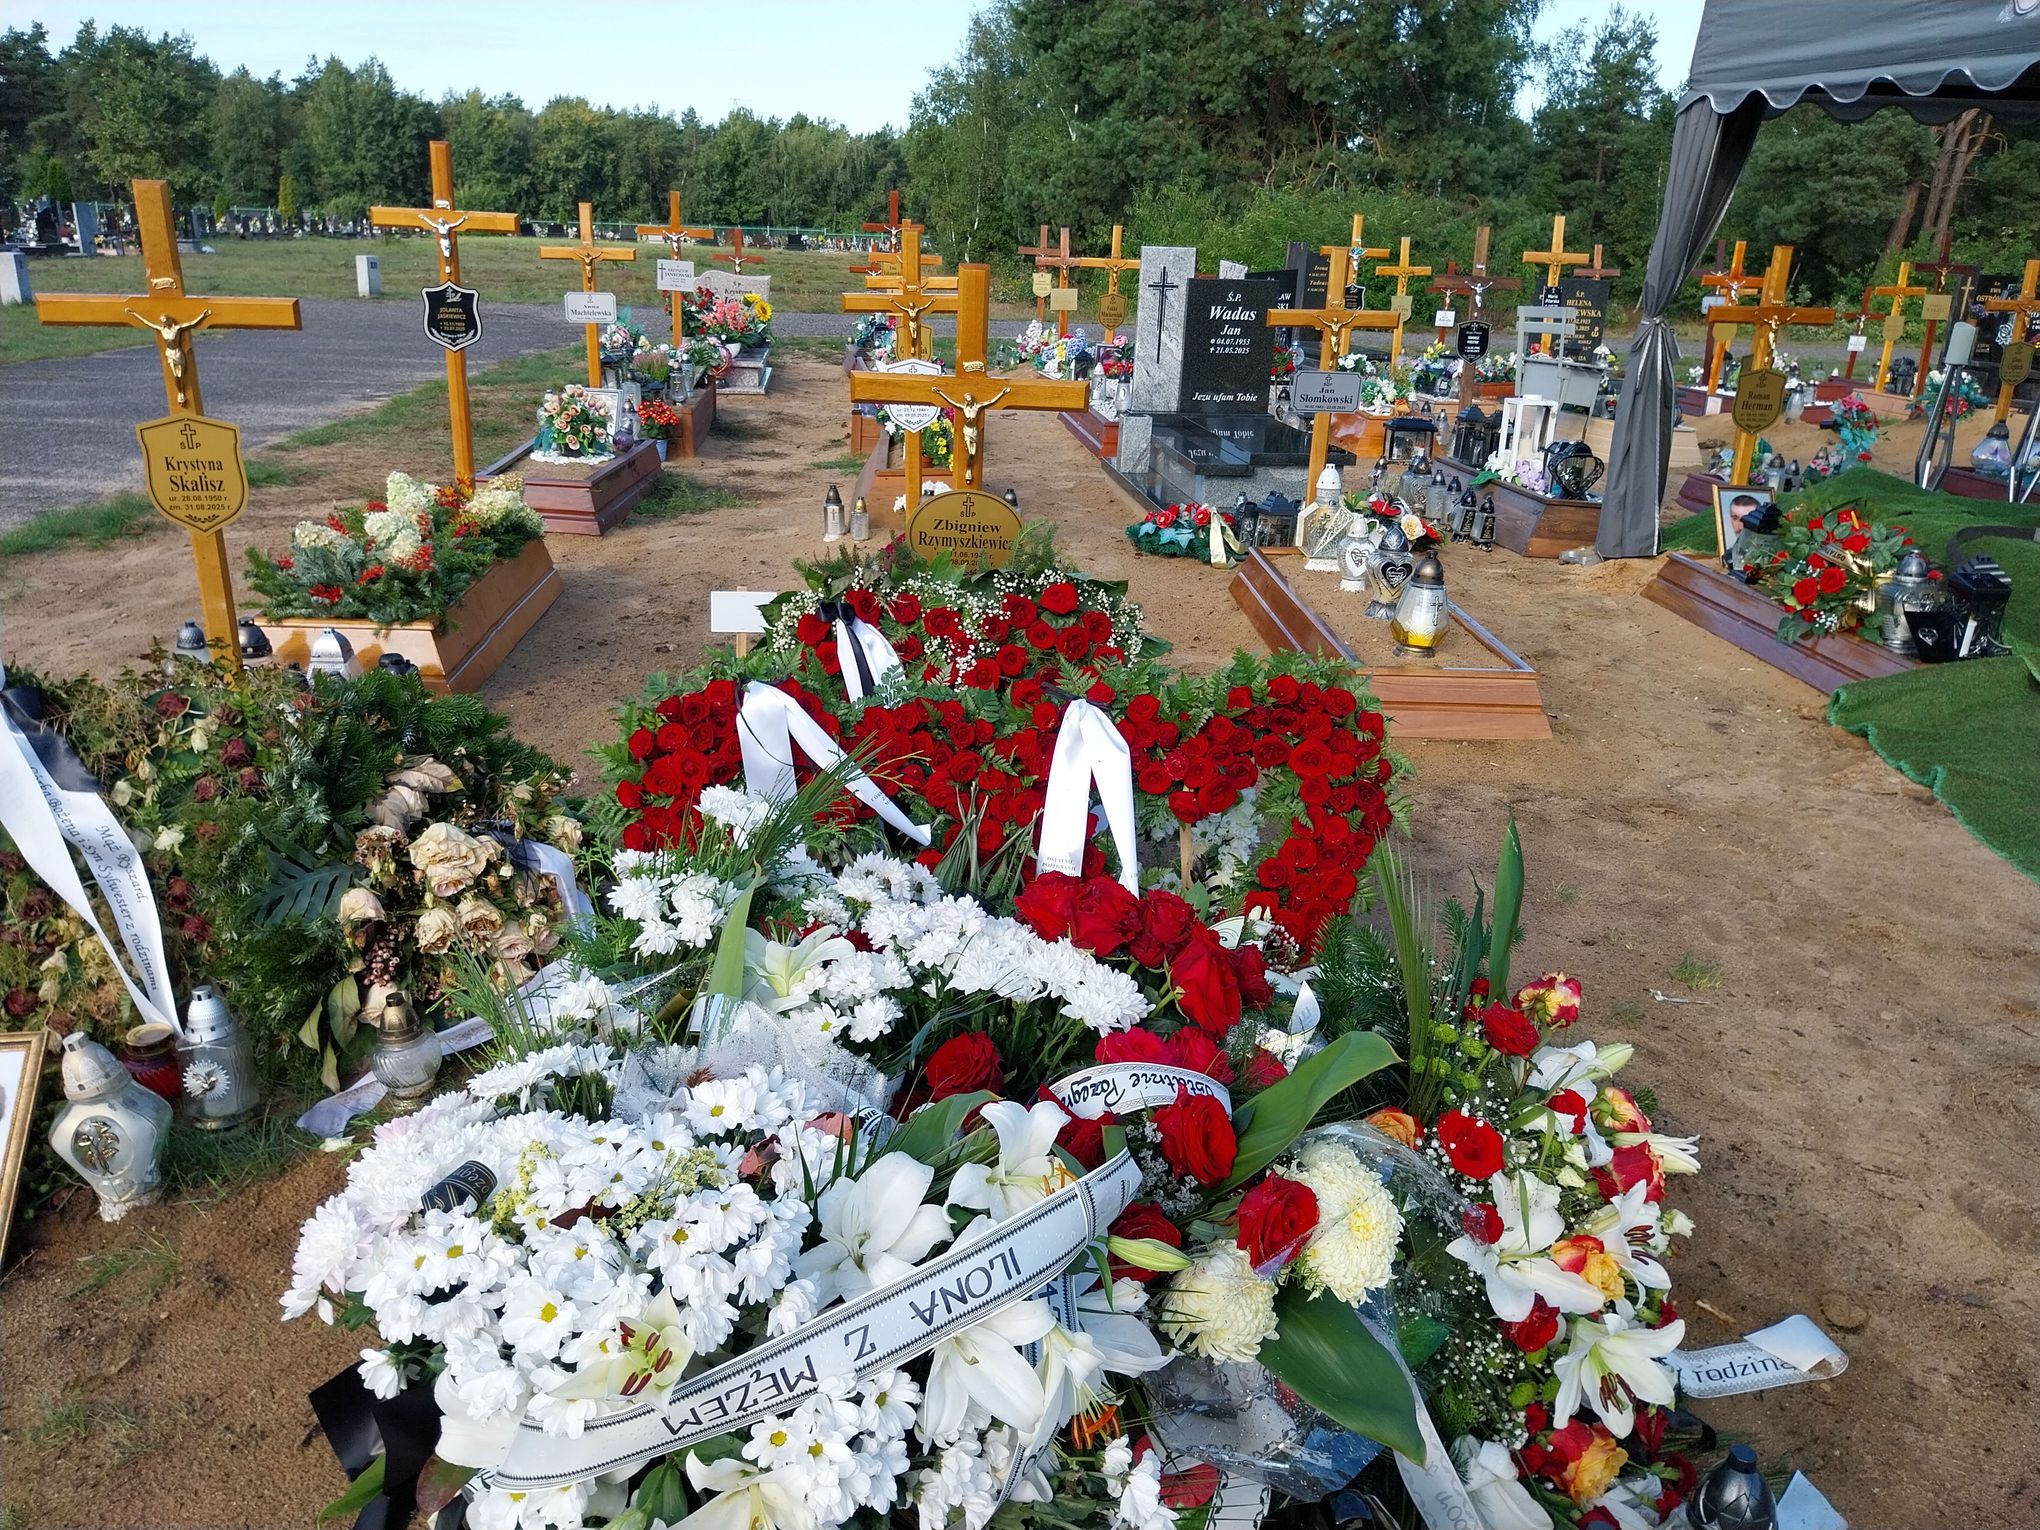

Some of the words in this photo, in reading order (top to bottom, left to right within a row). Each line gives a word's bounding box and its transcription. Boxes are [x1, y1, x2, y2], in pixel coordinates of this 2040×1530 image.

[1227, 291, 1242, 302] Ś.P.
[1210, 306, 1256, 320] Wadas
[1220, 325, 1241, 335] Jan
[1192, 392, 1211, 401] Jezu
[1213, 392, 1234, 402] ufam
[1237, 392, 1258, 401] Tobie
[1300, 394, 1353, 404] Słomkowski
[1741, 400, 1773, 411] Herman
[165, 456, 223, 475] Krystyna
[169, 475, 225, 492] Skalisz
[934, 519, 1001, 534] Zbigniew
[96, 825, 122, 852] Mąż
[117, 853, 148, 903] Ryszard,
[49, 798, 80, 837] Bożena
[97, 864, 133, 921] Sylwester
[130, 933, 158, 990] rodzinami
[909, 1247, 1022, 1326] ILONA
[844, 1324, 877, 1362] Z
[661, 1355, 818, 1436] MĘŻEM
